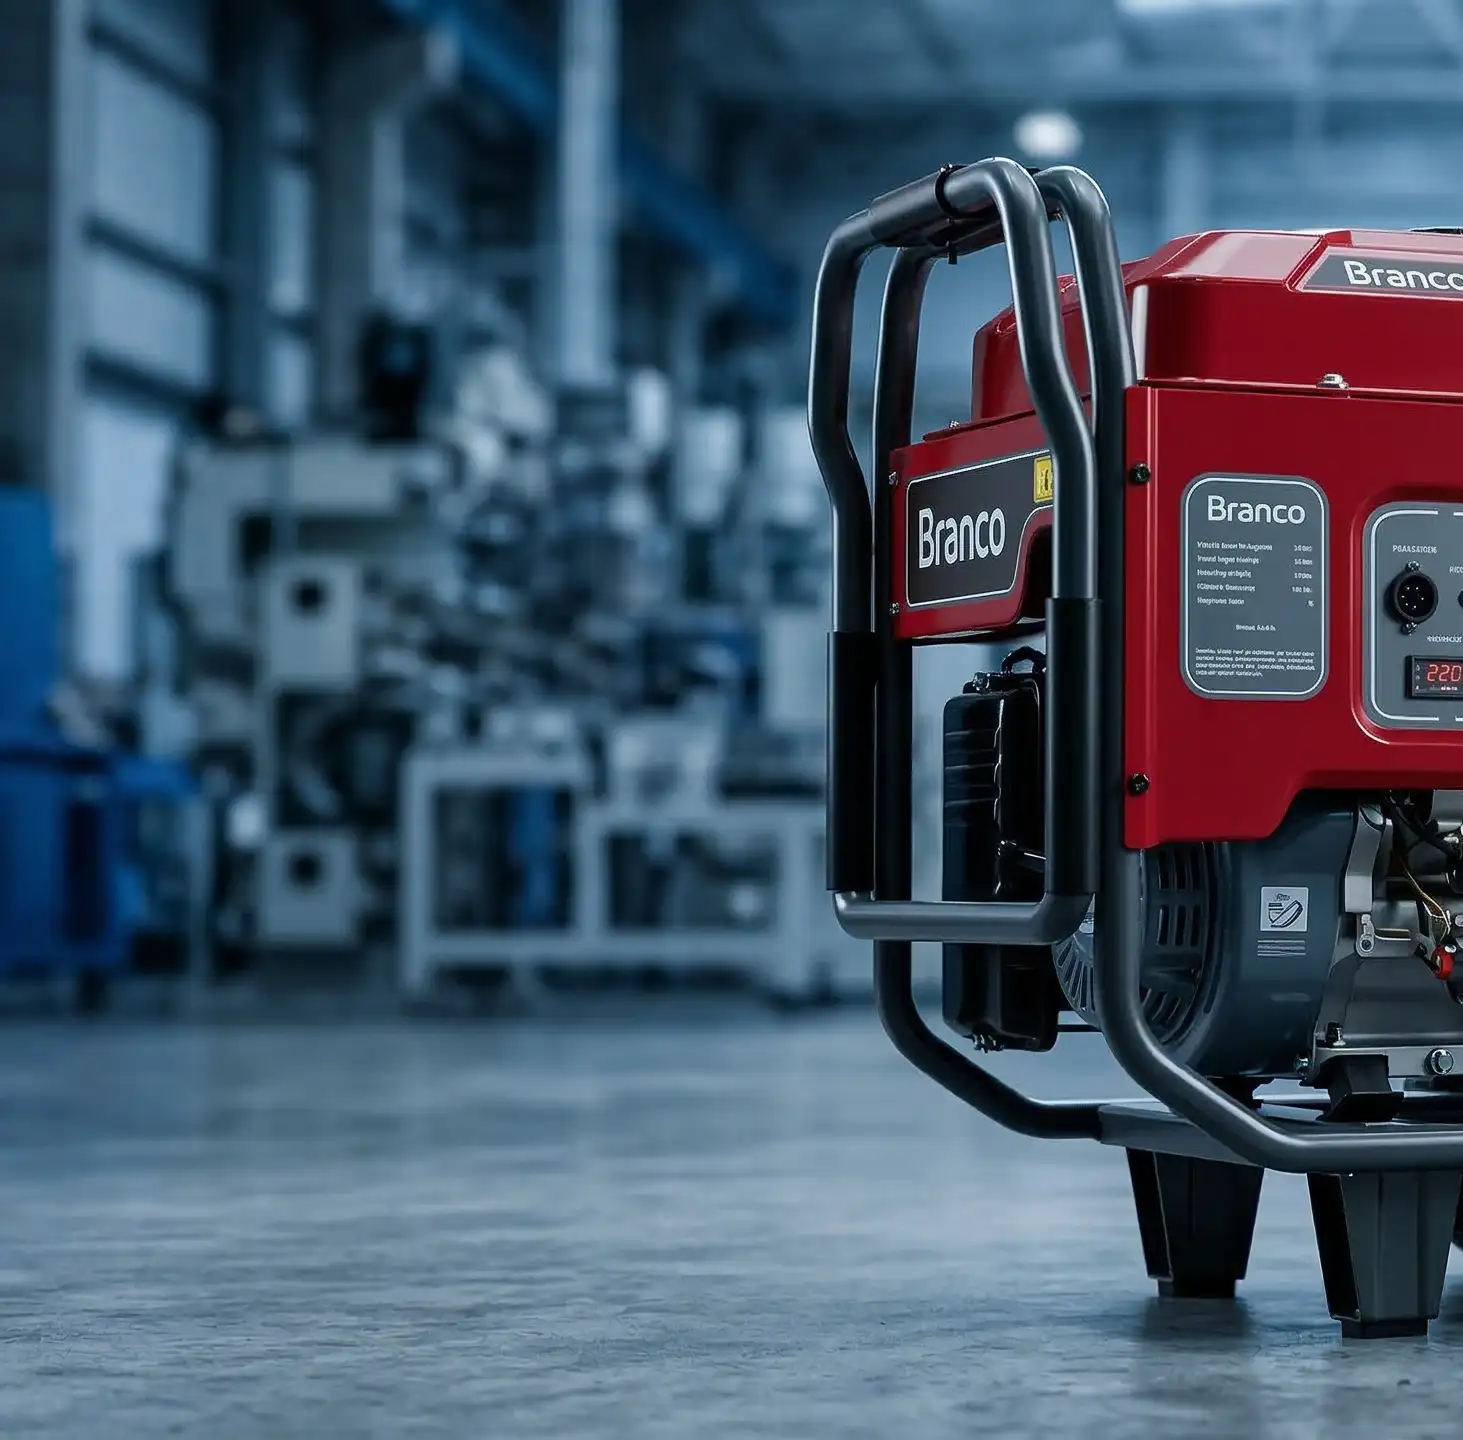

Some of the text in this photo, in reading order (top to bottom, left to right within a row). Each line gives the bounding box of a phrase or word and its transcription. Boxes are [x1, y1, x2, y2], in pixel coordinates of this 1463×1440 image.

[1207, 495, 1306, 525] Branco
[918, 507, 1006, 569] Branco
[1427, 664, 1462, 682] 220
